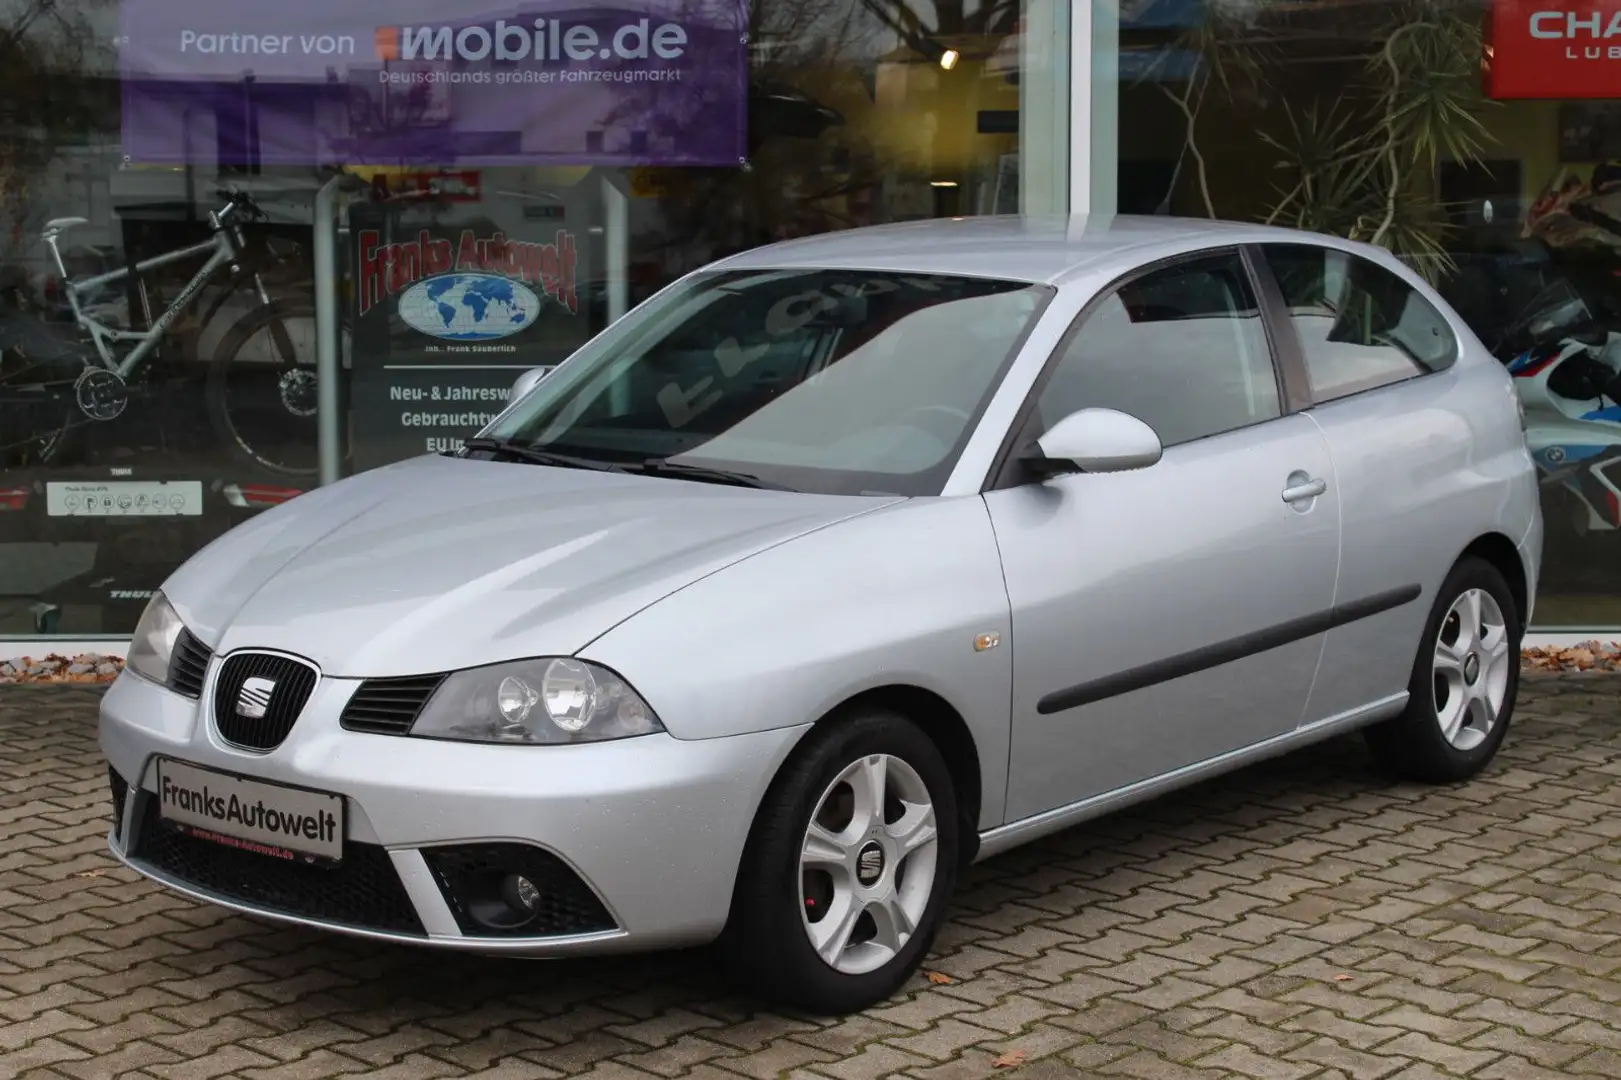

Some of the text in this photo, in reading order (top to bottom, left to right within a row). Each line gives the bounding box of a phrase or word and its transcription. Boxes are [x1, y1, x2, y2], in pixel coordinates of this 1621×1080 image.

[180, 30, 355, 54] Partner von
[401, 18, 688, 61] mobile.de
[1566, 46, 1621, 59] LUB
[379, 68, 682, 85] Deutschlands größter Fahrzeugmarkt
[358, 229, 578, 317] Franks Autowelt
[447, 344, 471, 353] Frank
[390, 386, 428, 400] Neu-
[431, 386, 442, 400] &
[426, 437, 448, 452] EU
[162, 775, 337, 842] FranksAutowelt
